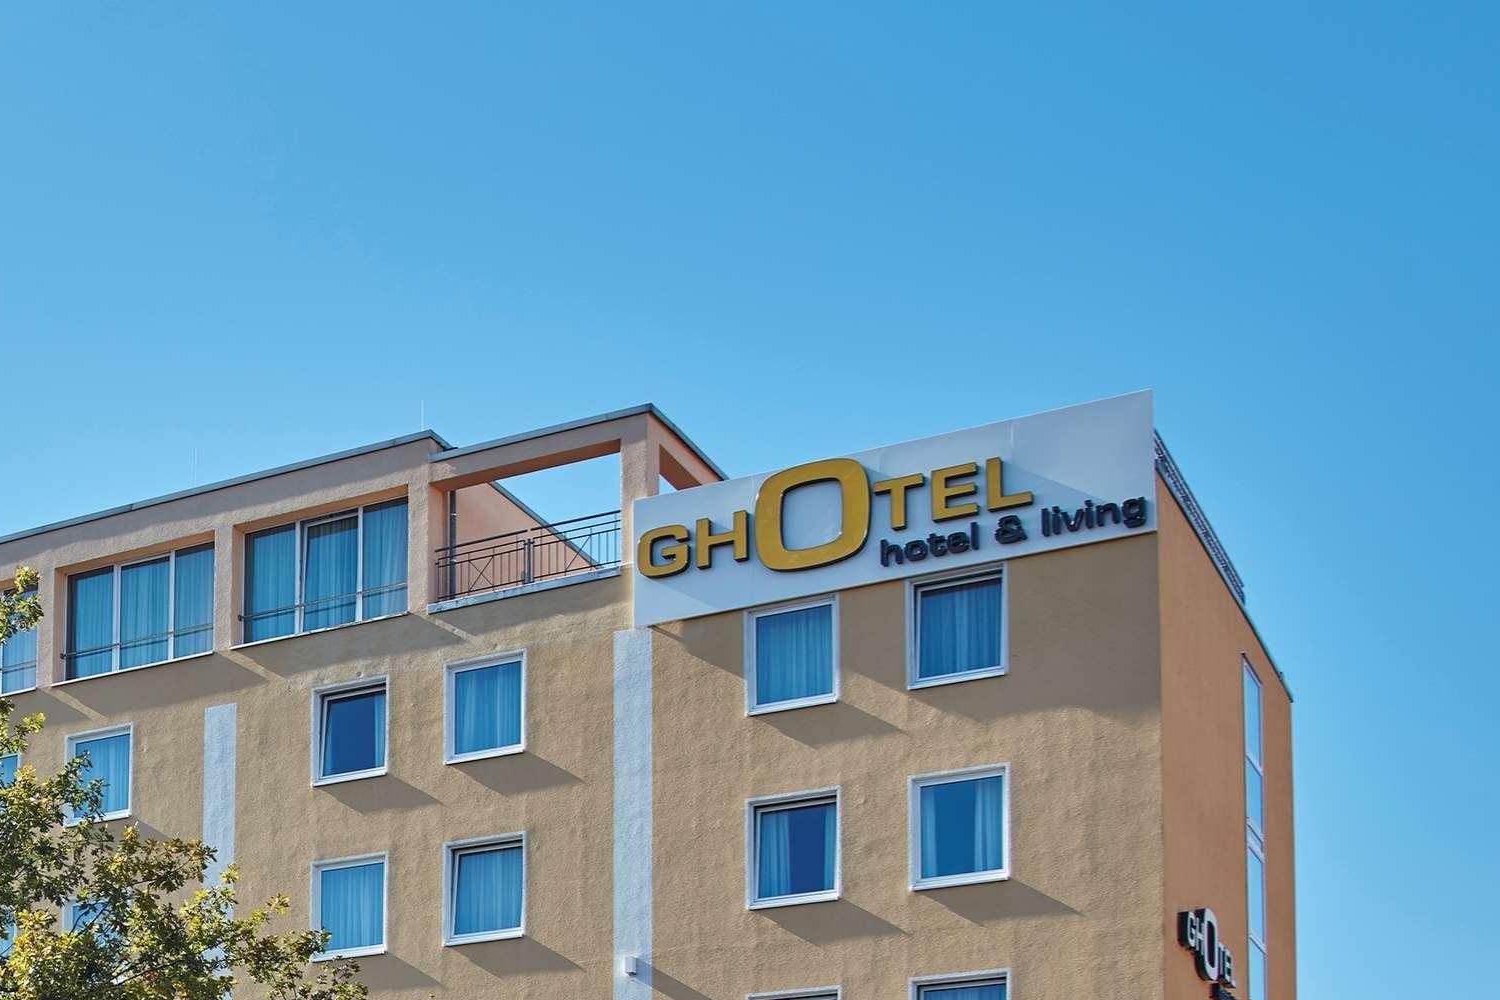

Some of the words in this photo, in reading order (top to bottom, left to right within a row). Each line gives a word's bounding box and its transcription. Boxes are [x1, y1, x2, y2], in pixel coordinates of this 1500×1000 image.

[637, 456, 1034, 578] GHOTEL
[880, 521, 980, 567] hotel
[995, 515, 1028, 544] &
[1040, 496, 1148, 537] living
